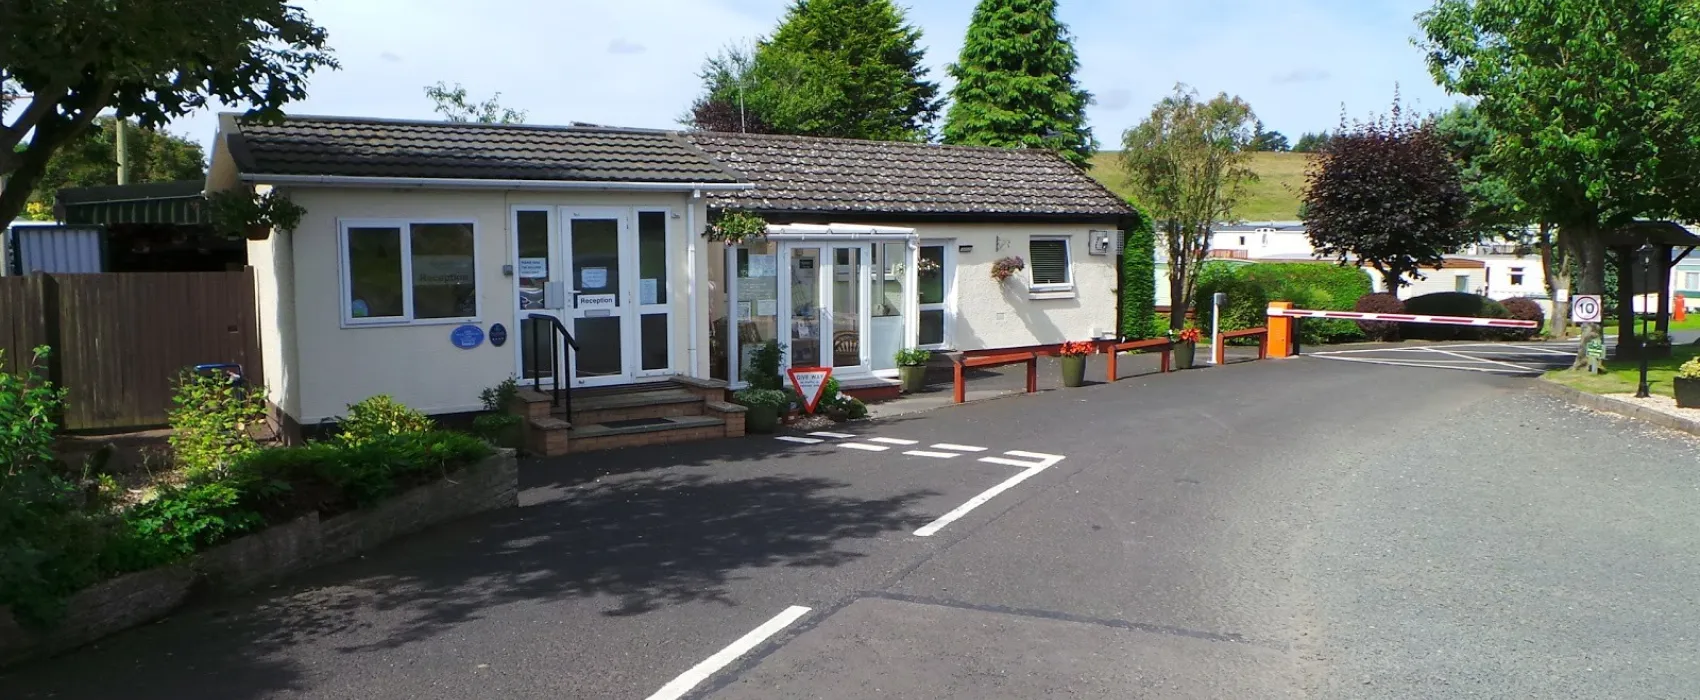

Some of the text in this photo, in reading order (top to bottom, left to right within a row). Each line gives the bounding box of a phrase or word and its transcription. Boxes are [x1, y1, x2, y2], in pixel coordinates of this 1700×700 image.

[420, 273, 469, 284] Reception
[580, 297, 613, 305] Reception
[1579, 302, 1595, 314] 10
